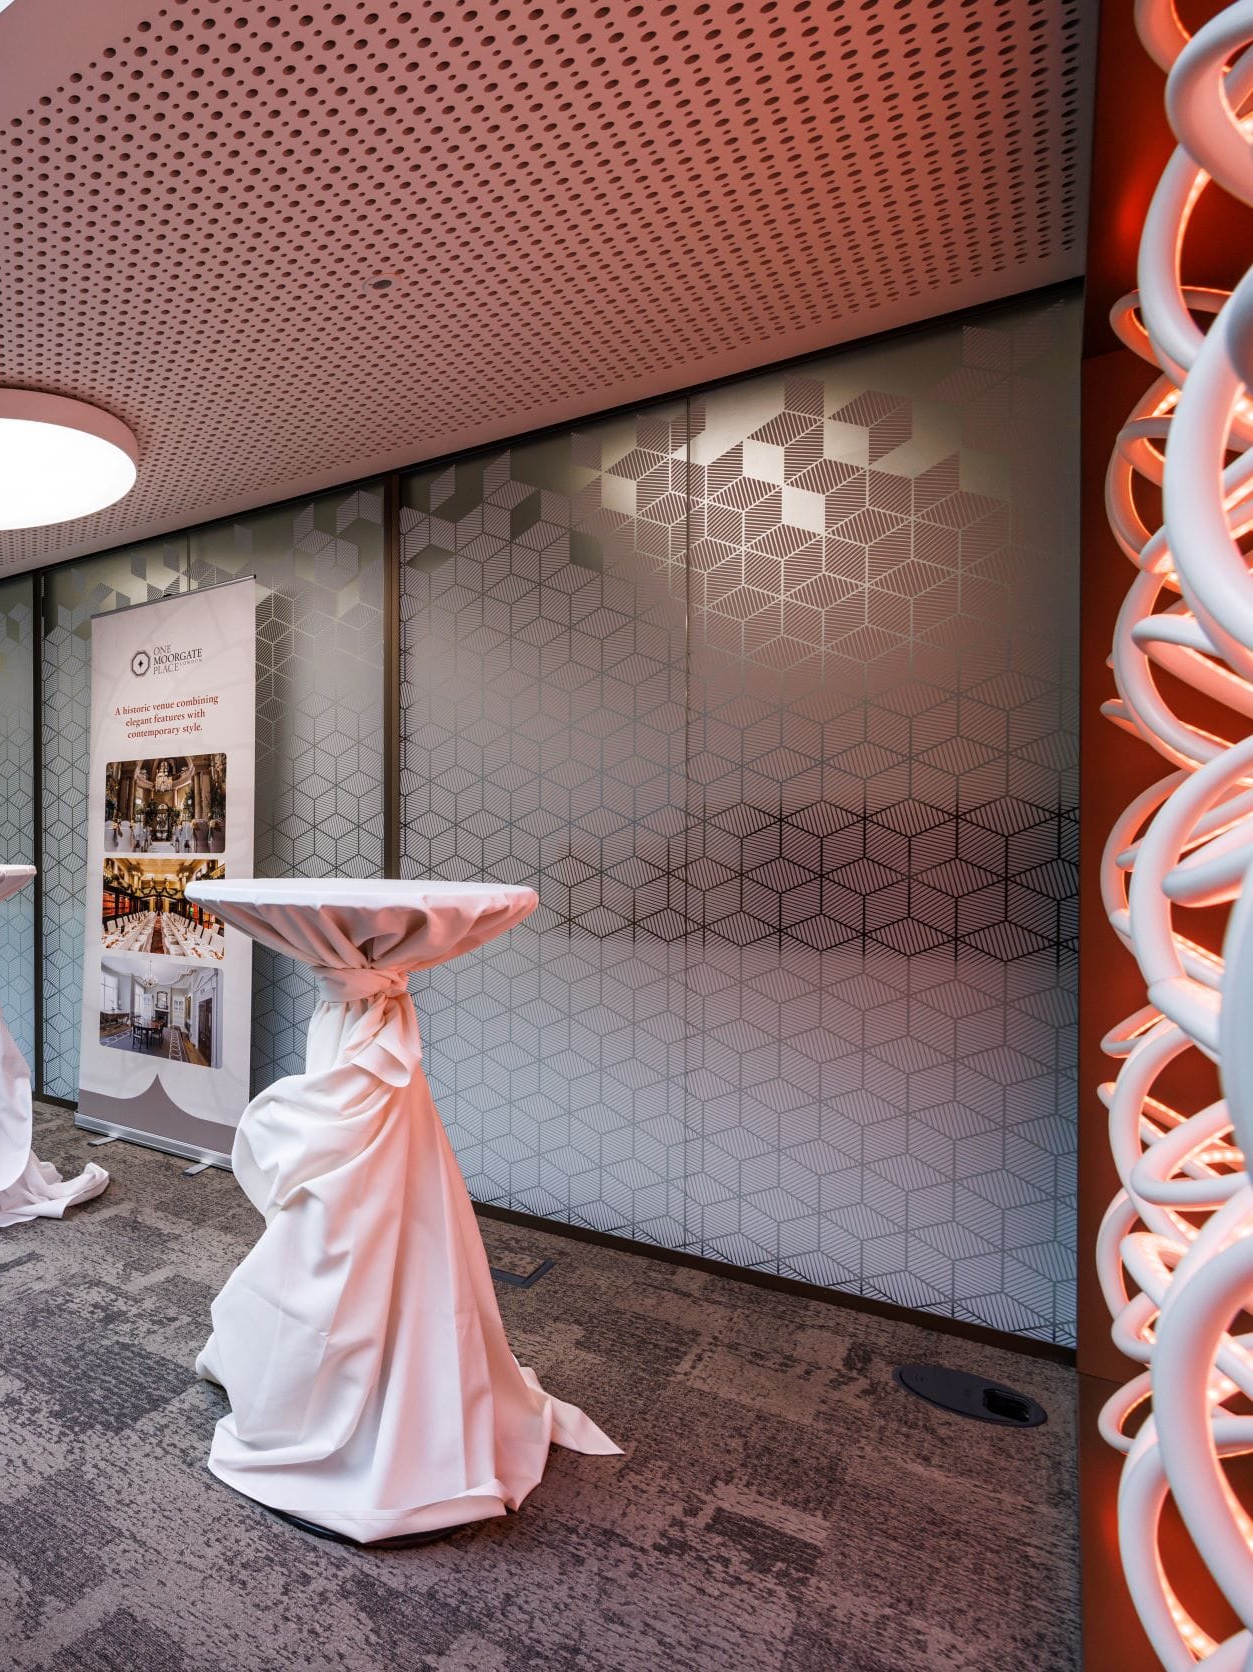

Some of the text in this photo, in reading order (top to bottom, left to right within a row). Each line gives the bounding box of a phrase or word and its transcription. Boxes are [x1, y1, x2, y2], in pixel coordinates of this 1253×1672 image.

[153, 645, 172, 656] ONE
[153, 648, 203, 665] MOORGATE
[153, 663, 179, 675] PLACE
[114, 695, 219, 716] A historic venue combining
[125, 708, 206, 728] elegant features with
[127, 723, 203, 738] contemporary style.
